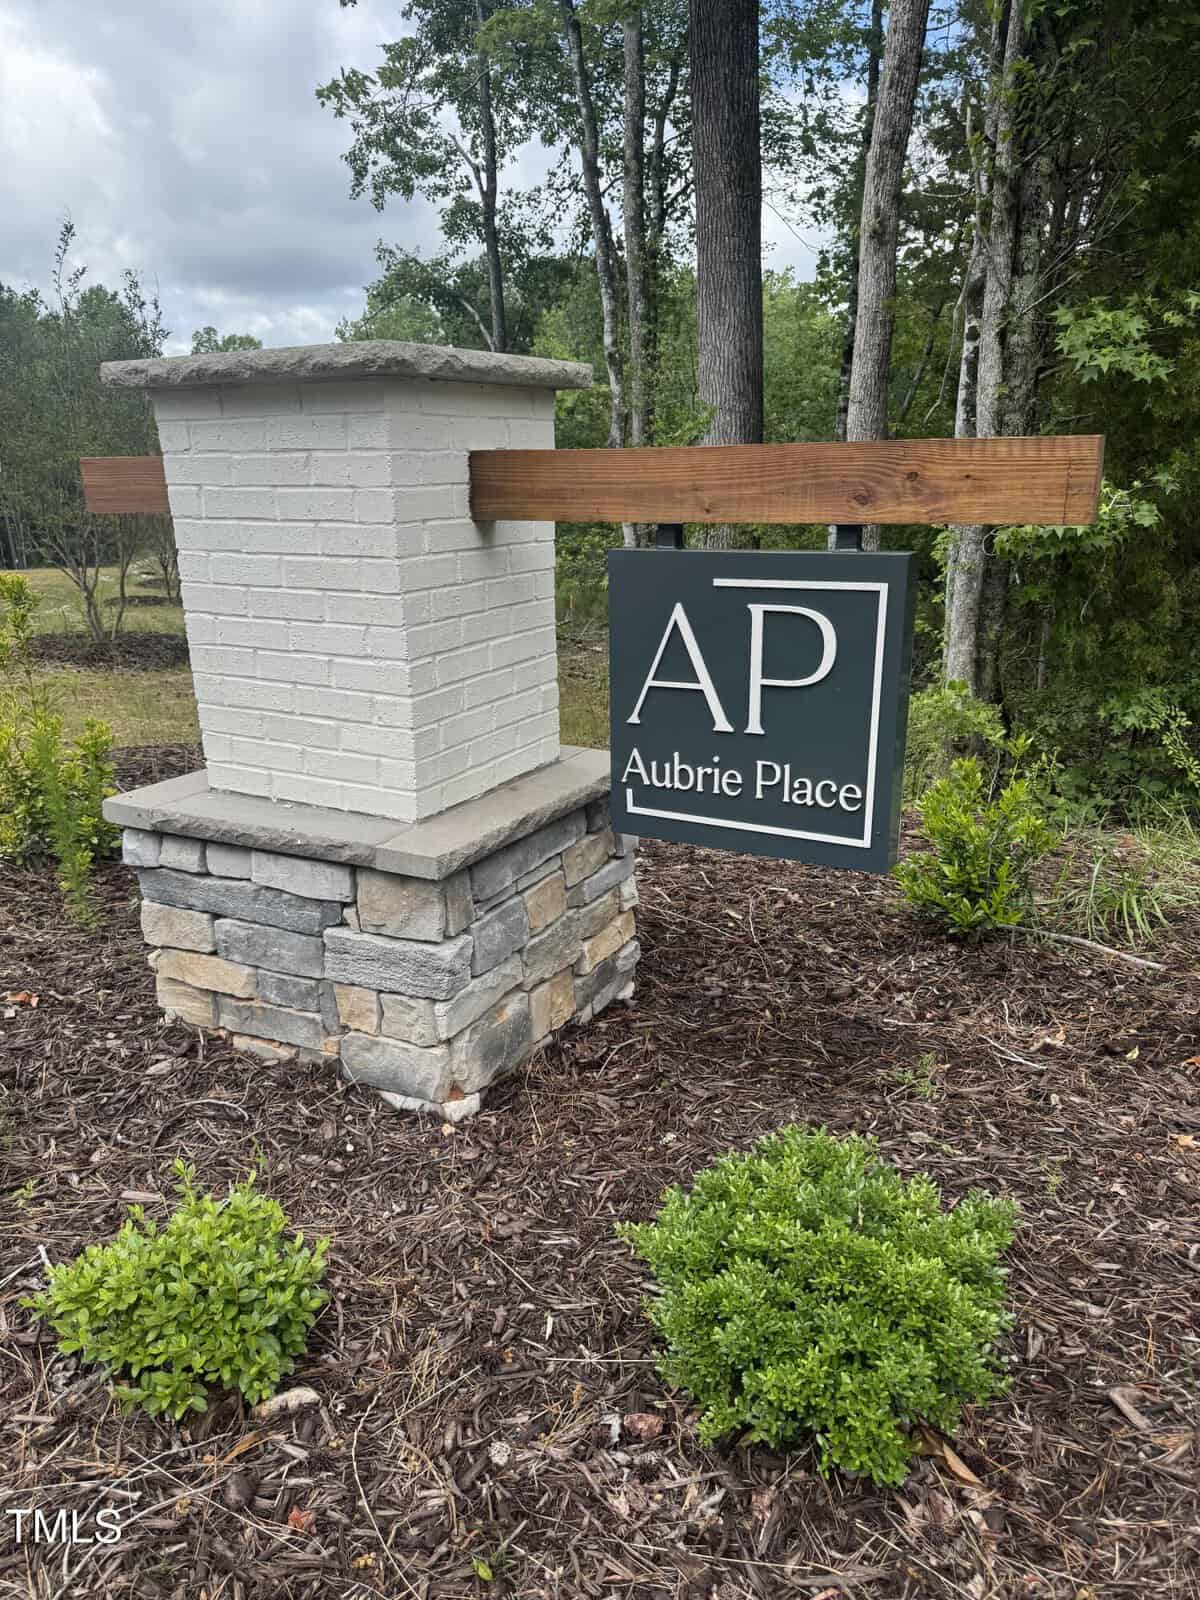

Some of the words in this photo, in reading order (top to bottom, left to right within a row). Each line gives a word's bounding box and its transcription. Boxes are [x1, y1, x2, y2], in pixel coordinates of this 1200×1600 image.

[625, 602, 838, 735] AP
[621, 747, 743, 796] Aubrie
[754, 760, 863, 812] Place
